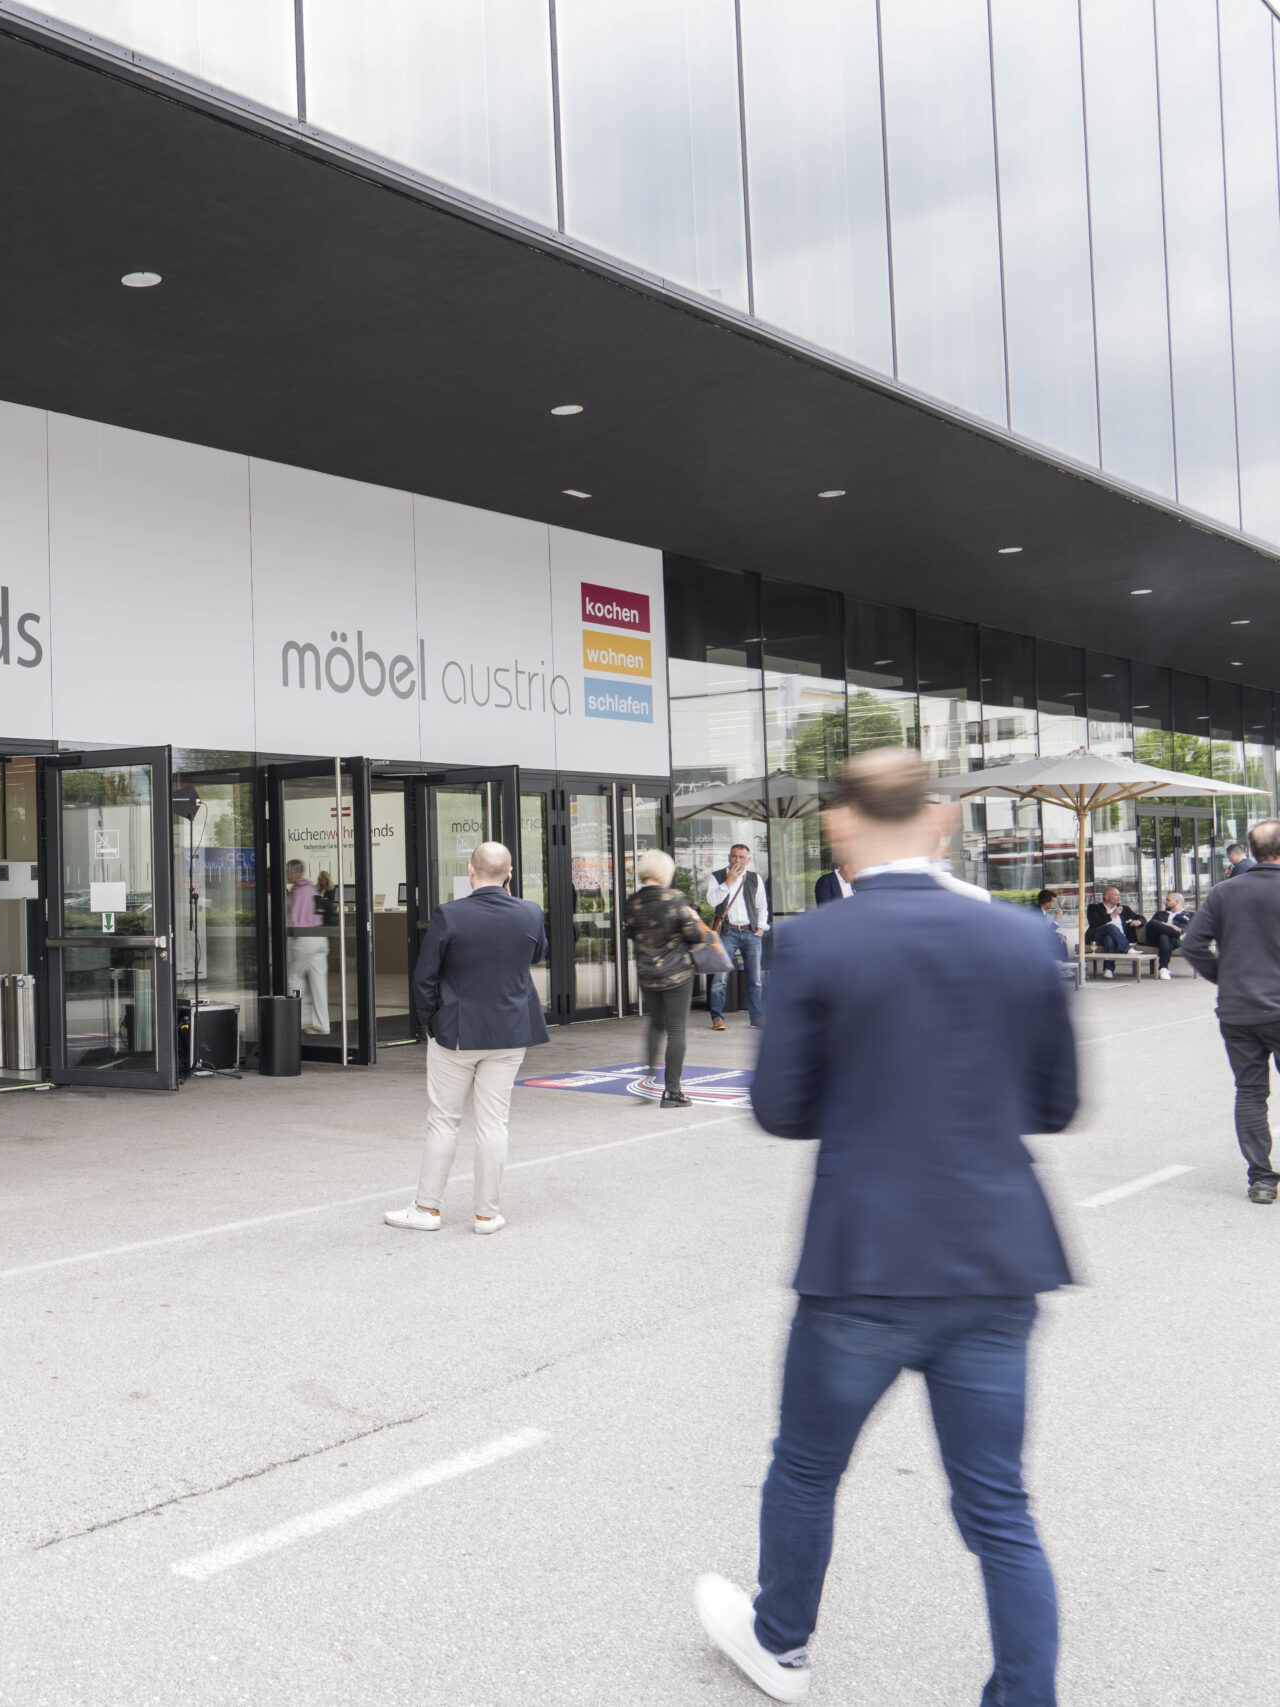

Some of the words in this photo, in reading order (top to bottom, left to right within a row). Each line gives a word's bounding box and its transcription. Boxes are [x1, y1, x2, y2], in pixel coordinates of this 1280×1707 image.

[585, 597, 639, 624] kochen
[586, 648, 644, 670] wohnen
[282, 630, 427, 701] möbel
[442, 659, 571, 715] austria
[588, 693, 649, 716] schlafen
